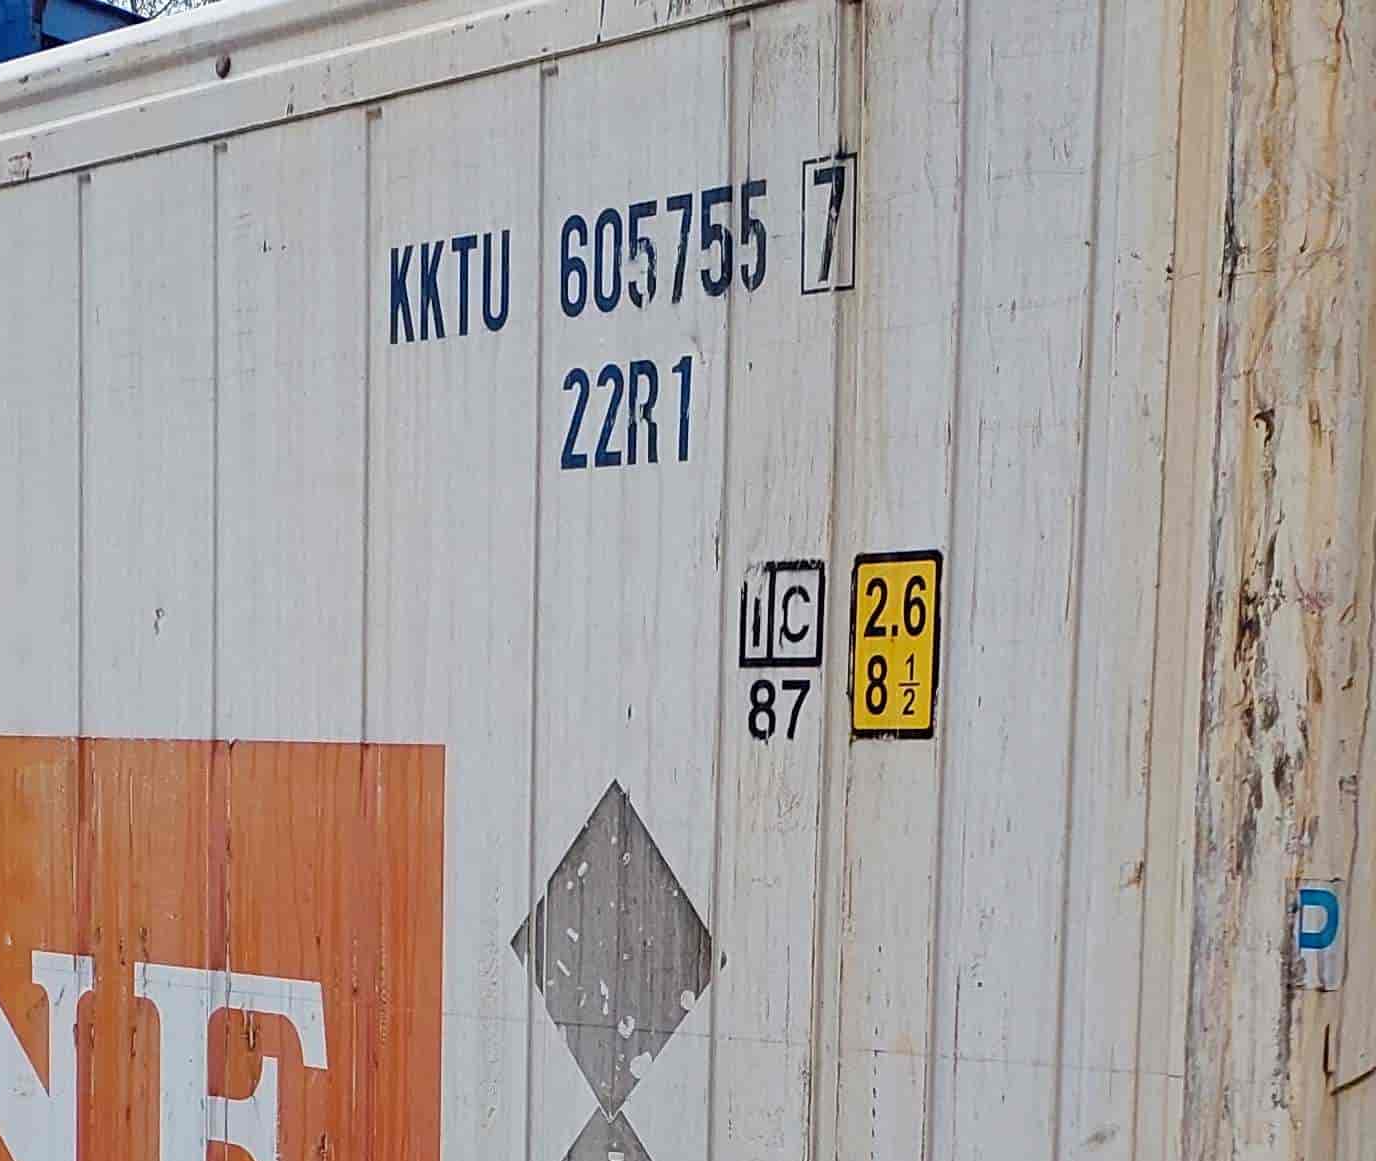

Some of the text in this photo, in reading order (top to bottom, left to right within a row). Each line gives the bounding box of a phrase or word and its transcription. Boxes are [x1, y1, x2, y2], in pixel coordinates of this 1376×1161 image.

[390, 166, 846, 345] KKTU 605755 7
[560, 355, 693, 470] 22R1
[863, 575, 927, 638] 2.6
[748, 679, 812, 745] 87
